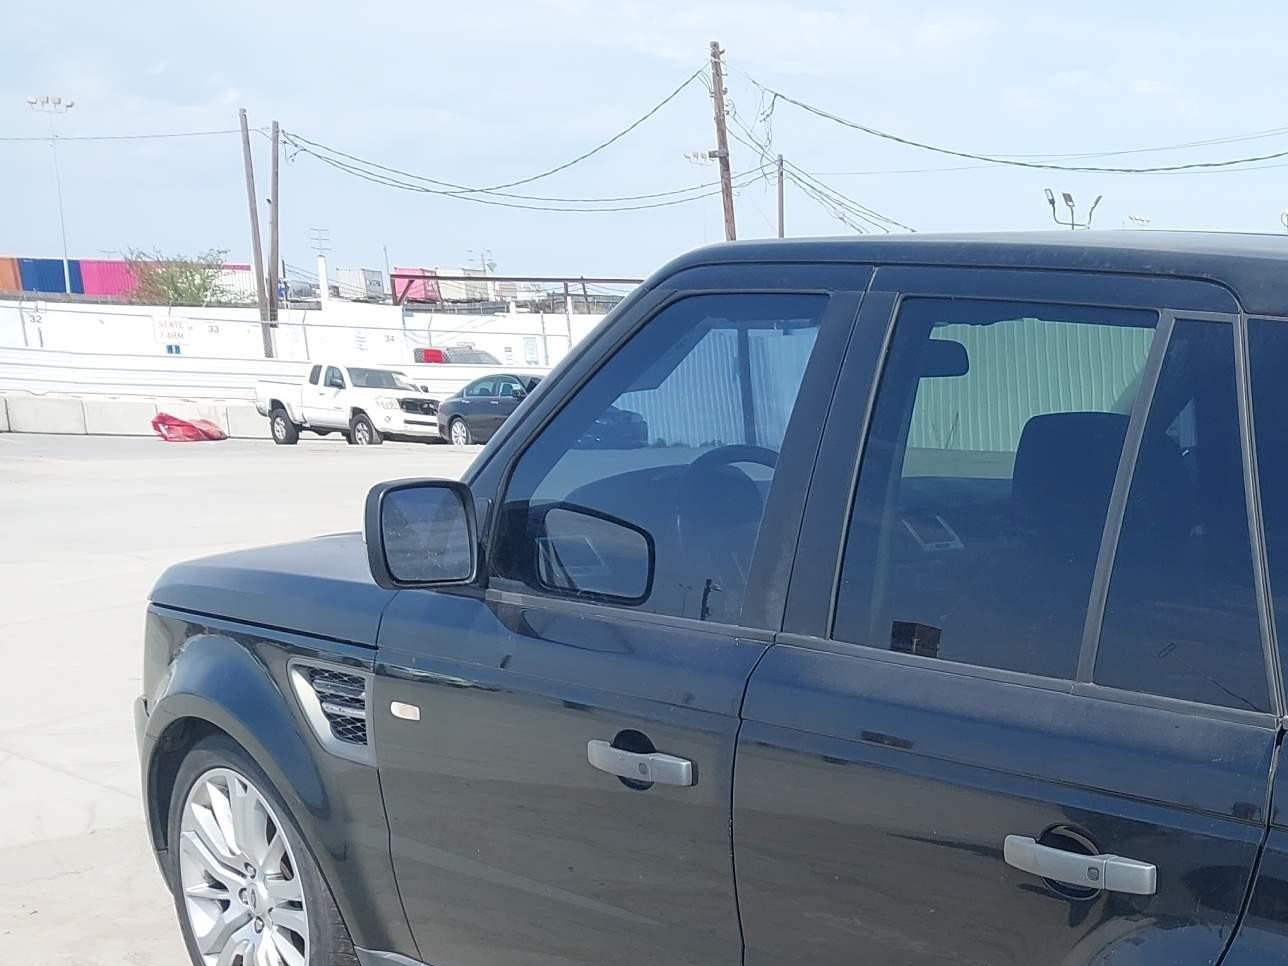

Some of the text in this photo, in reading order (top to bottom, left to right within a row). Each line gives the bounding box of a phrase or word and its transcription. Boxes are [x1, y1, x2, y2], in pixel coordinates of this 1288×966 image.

[30, 314, 42, 324] 32
[159, 320, 184, 329] STATE
[208, 325, 220, 333] 33
[159, 331, 184, 340] FARM
[384, 334, 395, 343] 34
